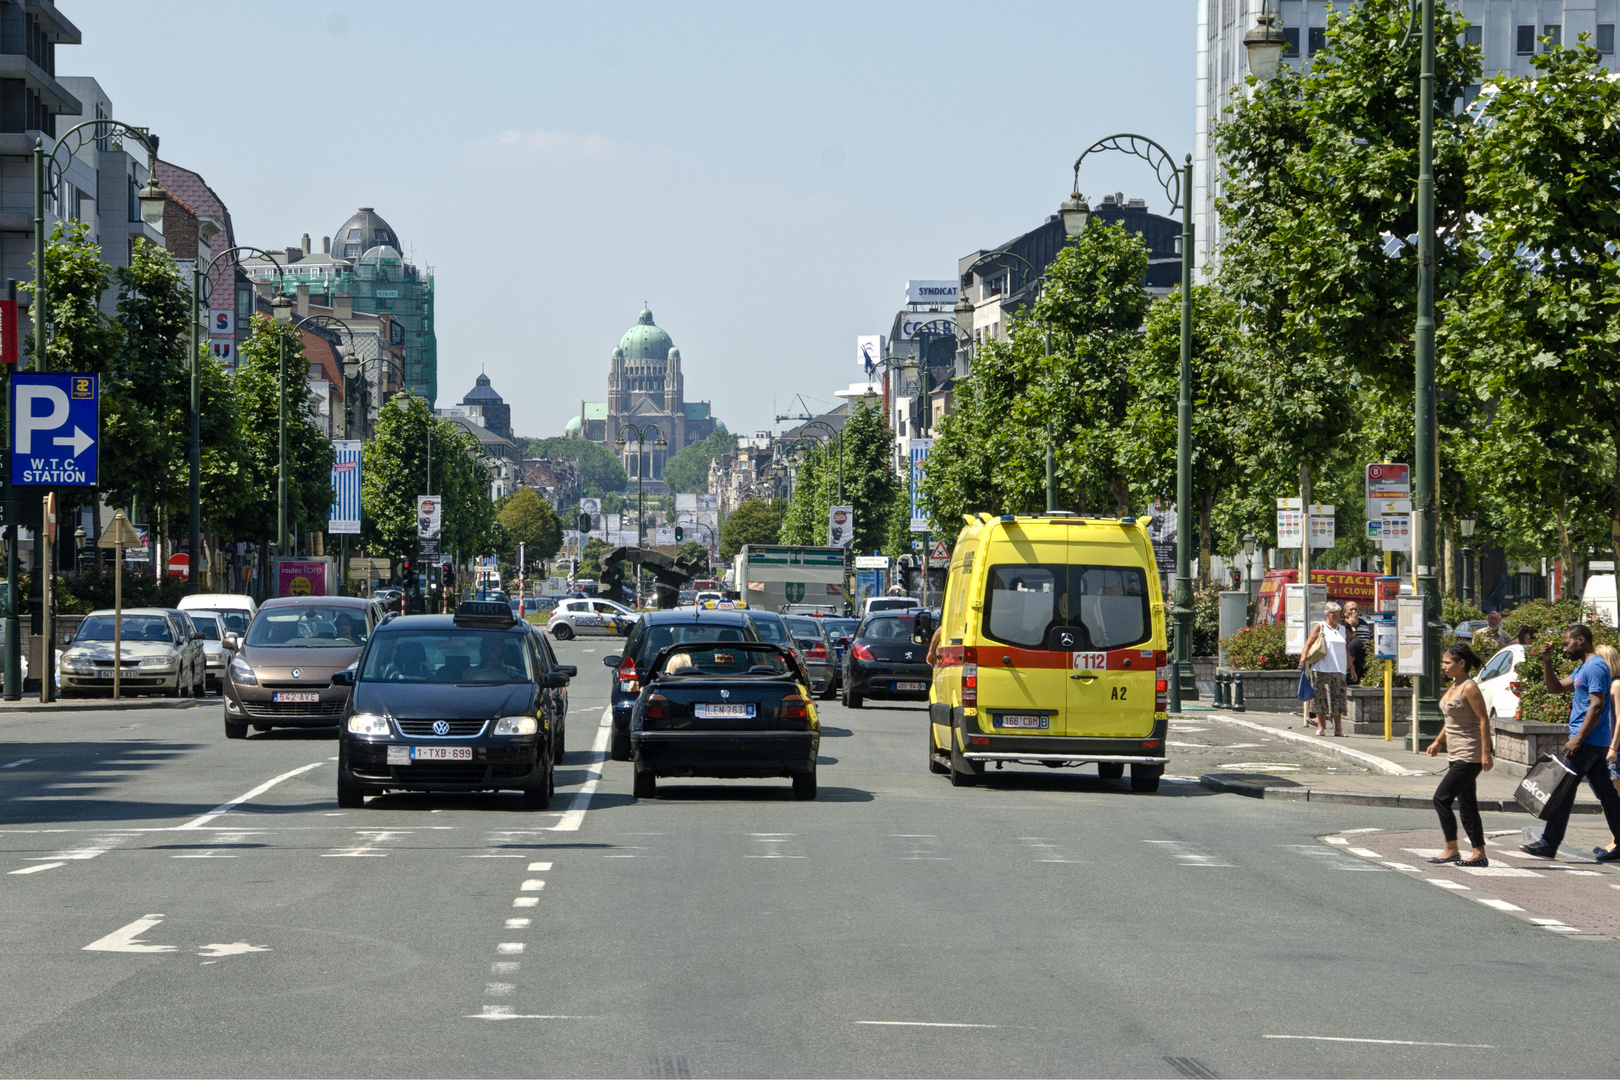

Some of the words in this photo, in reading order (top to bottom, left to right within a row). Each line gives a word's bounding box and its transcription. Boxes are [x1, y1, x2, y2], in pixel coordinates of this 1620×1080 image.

[919, 287, 957, 295] SYNDICAT
[15, 385, 70, 454] P
[30, 459, 78, 470] W.T.C.
[23, 471, 86, 482] STATION
[304, 565, 322, 574] libre
[471, 604, 498, 613] TAXI
[1082, 654, 1105, 669] 112
[1041, 717, 1048, 727] B
[1521, 779, 1552, 805] skol
